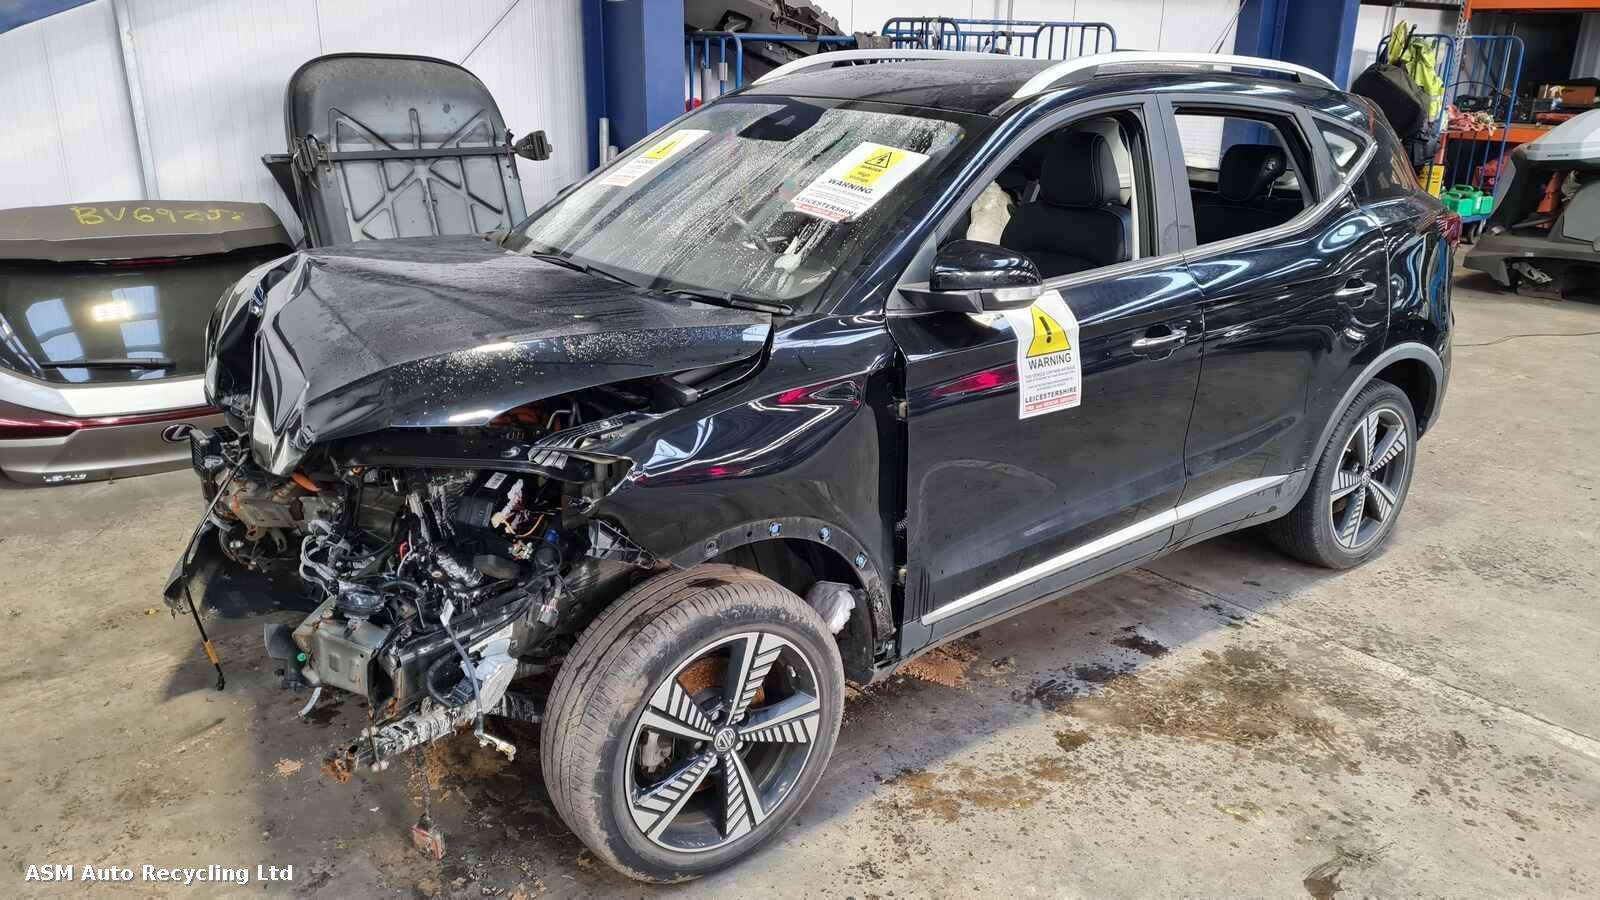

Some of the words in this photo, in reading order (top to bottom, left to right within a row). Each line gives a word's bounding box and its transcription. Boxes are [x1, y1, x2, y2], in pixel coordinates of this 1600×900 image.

[829, 178, 873, 194] WARNING
[1028, 352, 1072, 370] WARNING
[1025, 386, 1077, 404] LEICESTERSHIRE
